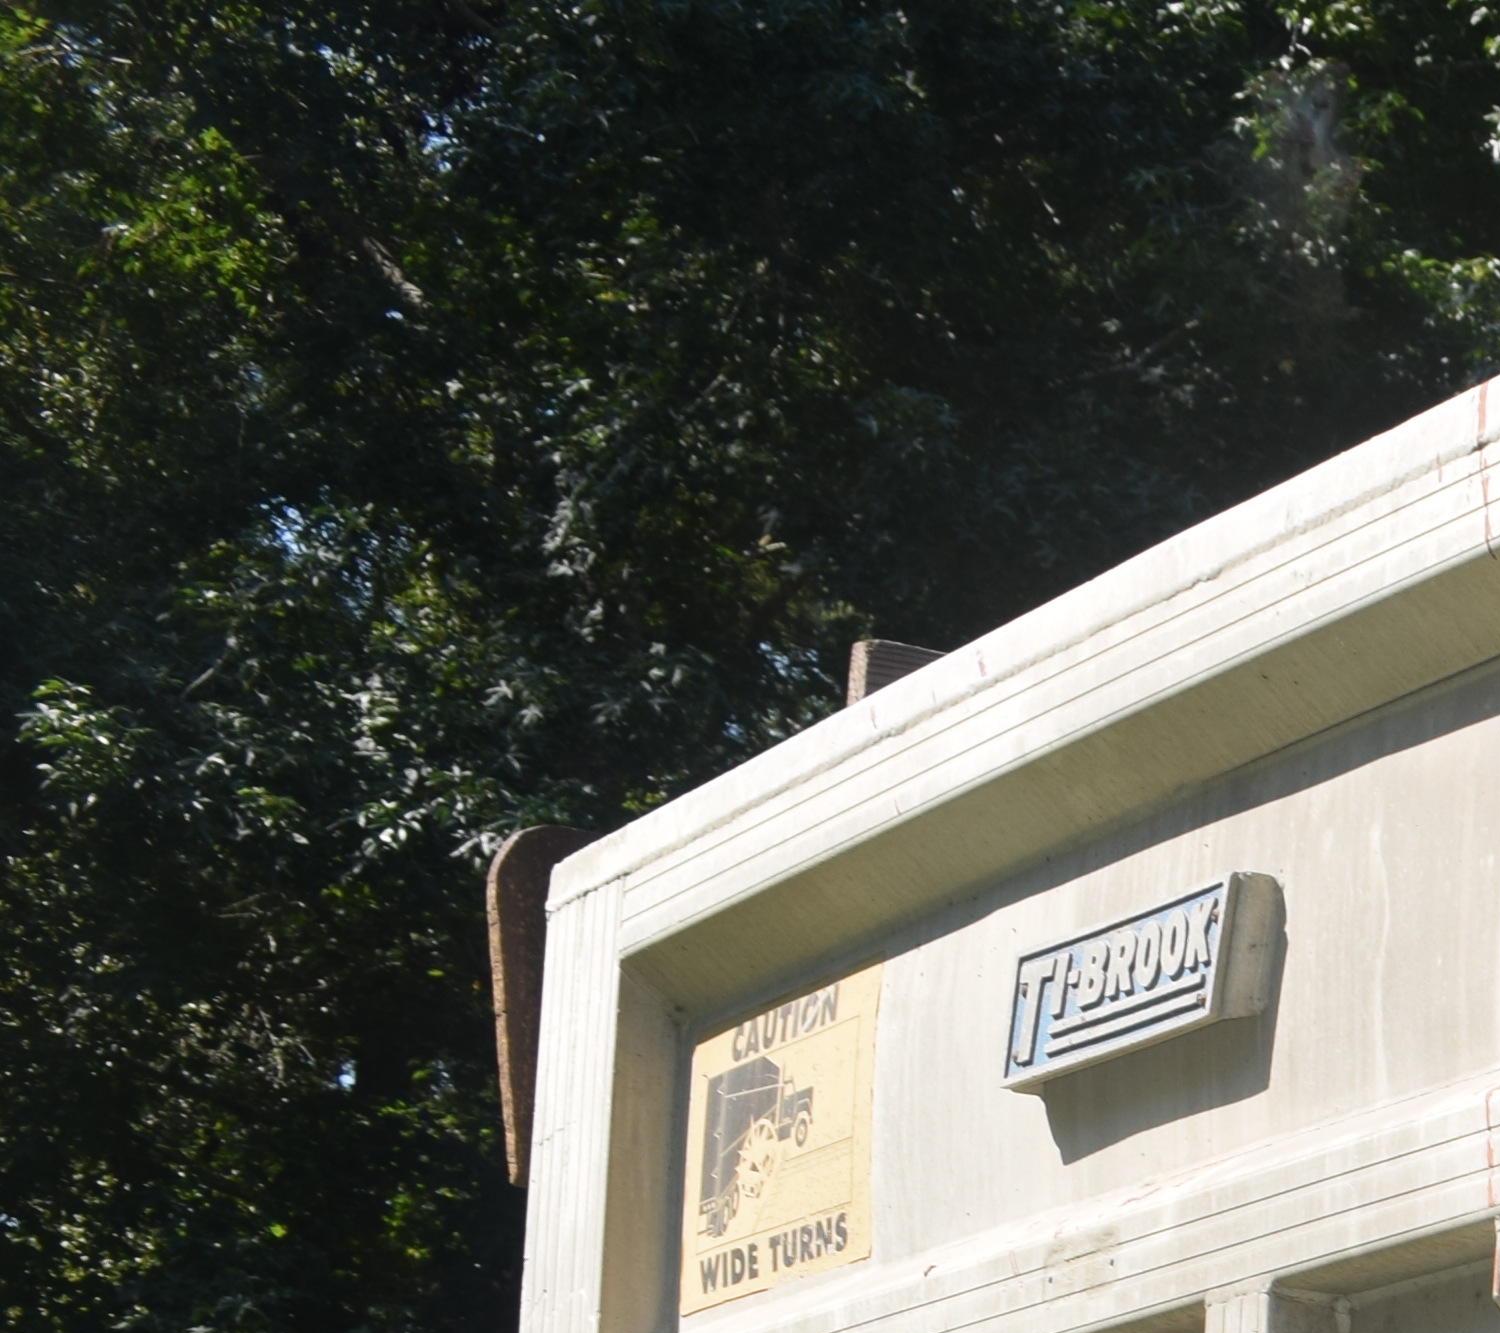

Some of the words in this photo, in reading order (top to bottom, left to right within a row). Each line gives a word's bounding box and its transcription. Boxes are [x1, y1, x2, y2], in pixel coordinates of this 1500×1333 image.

[1014, 898, 1218, 1064] TI-BROOK
[731, 983, 840, 1062] CAUTION
[700, 1242, 759, 1294] WIDE
[769, 1212, 848, 1273] TURNS
